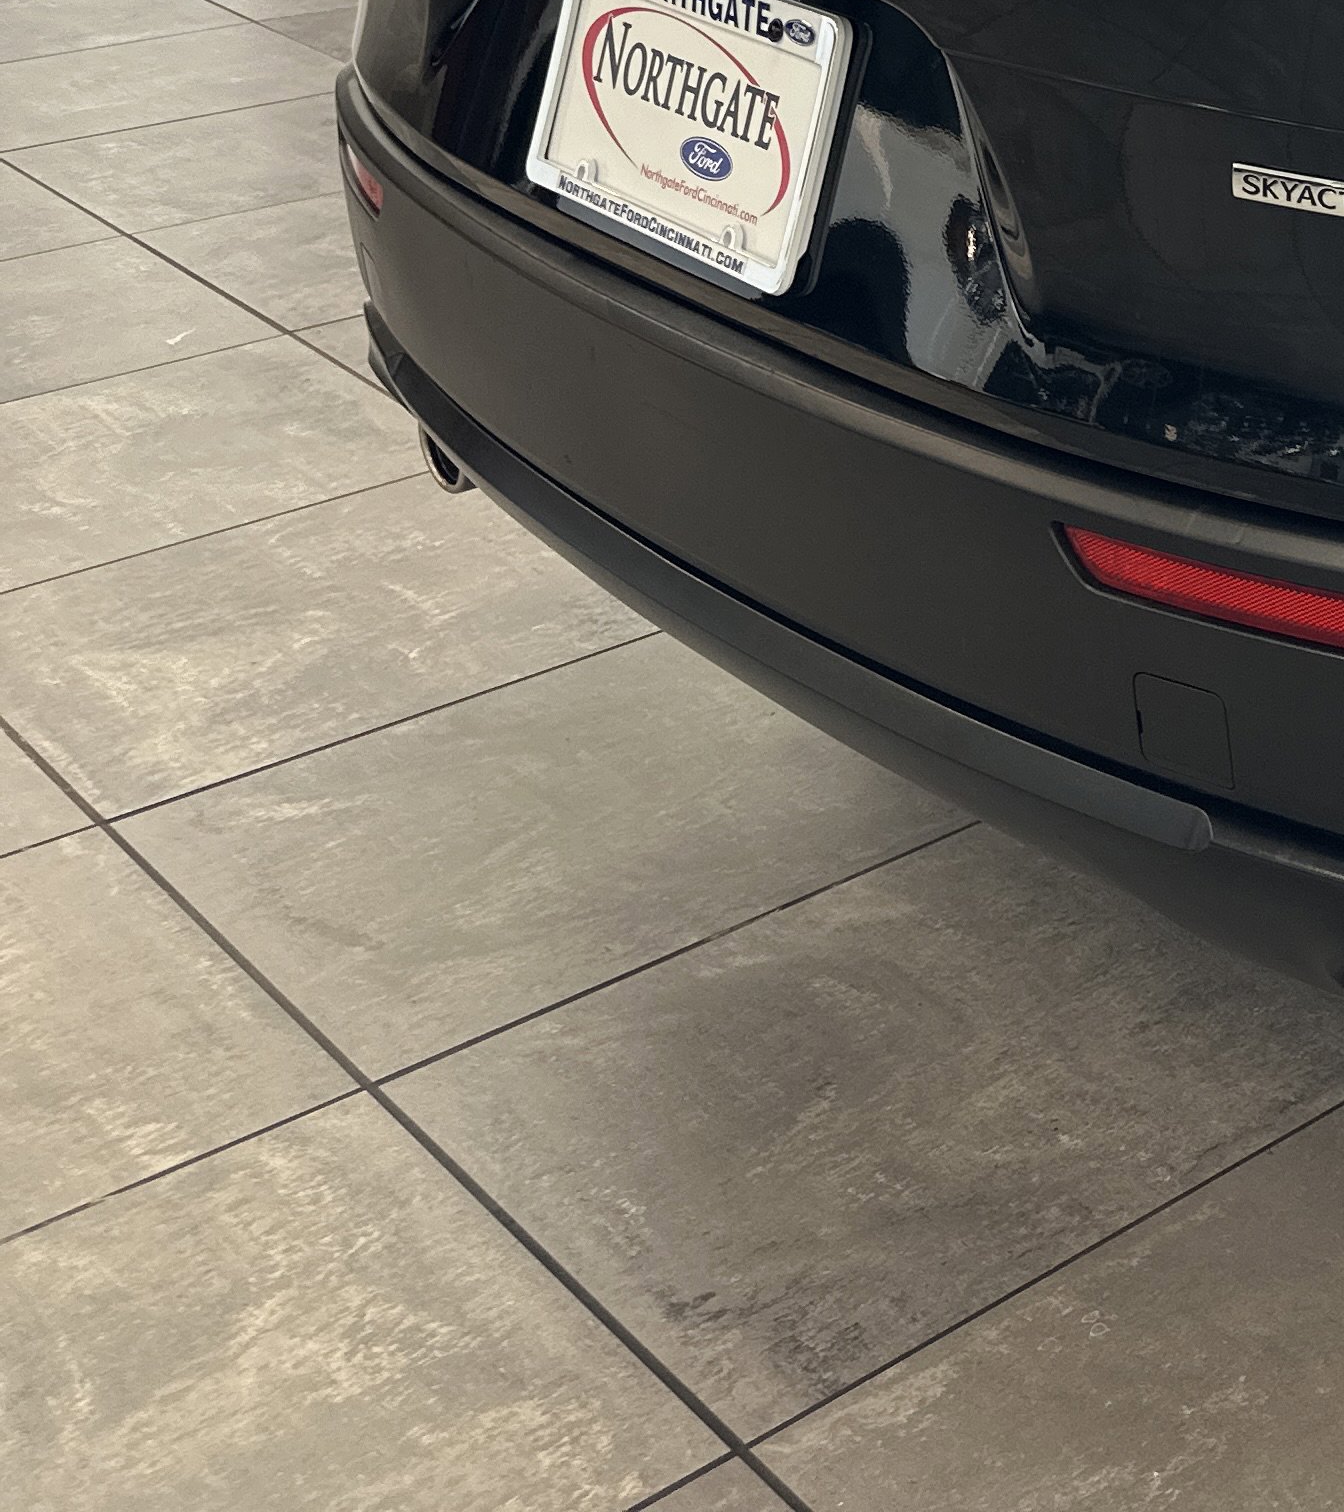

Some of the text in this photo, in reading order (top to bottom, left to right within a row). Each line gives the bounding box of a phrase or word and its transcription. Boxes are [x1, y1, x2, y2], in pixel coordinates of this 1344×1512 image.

[594, 20, 780, 150] NORTHGATE
[688, 141, 723, 174] Ford
[640, 162, 758, 226] NorthgateFordCincinnati.com
